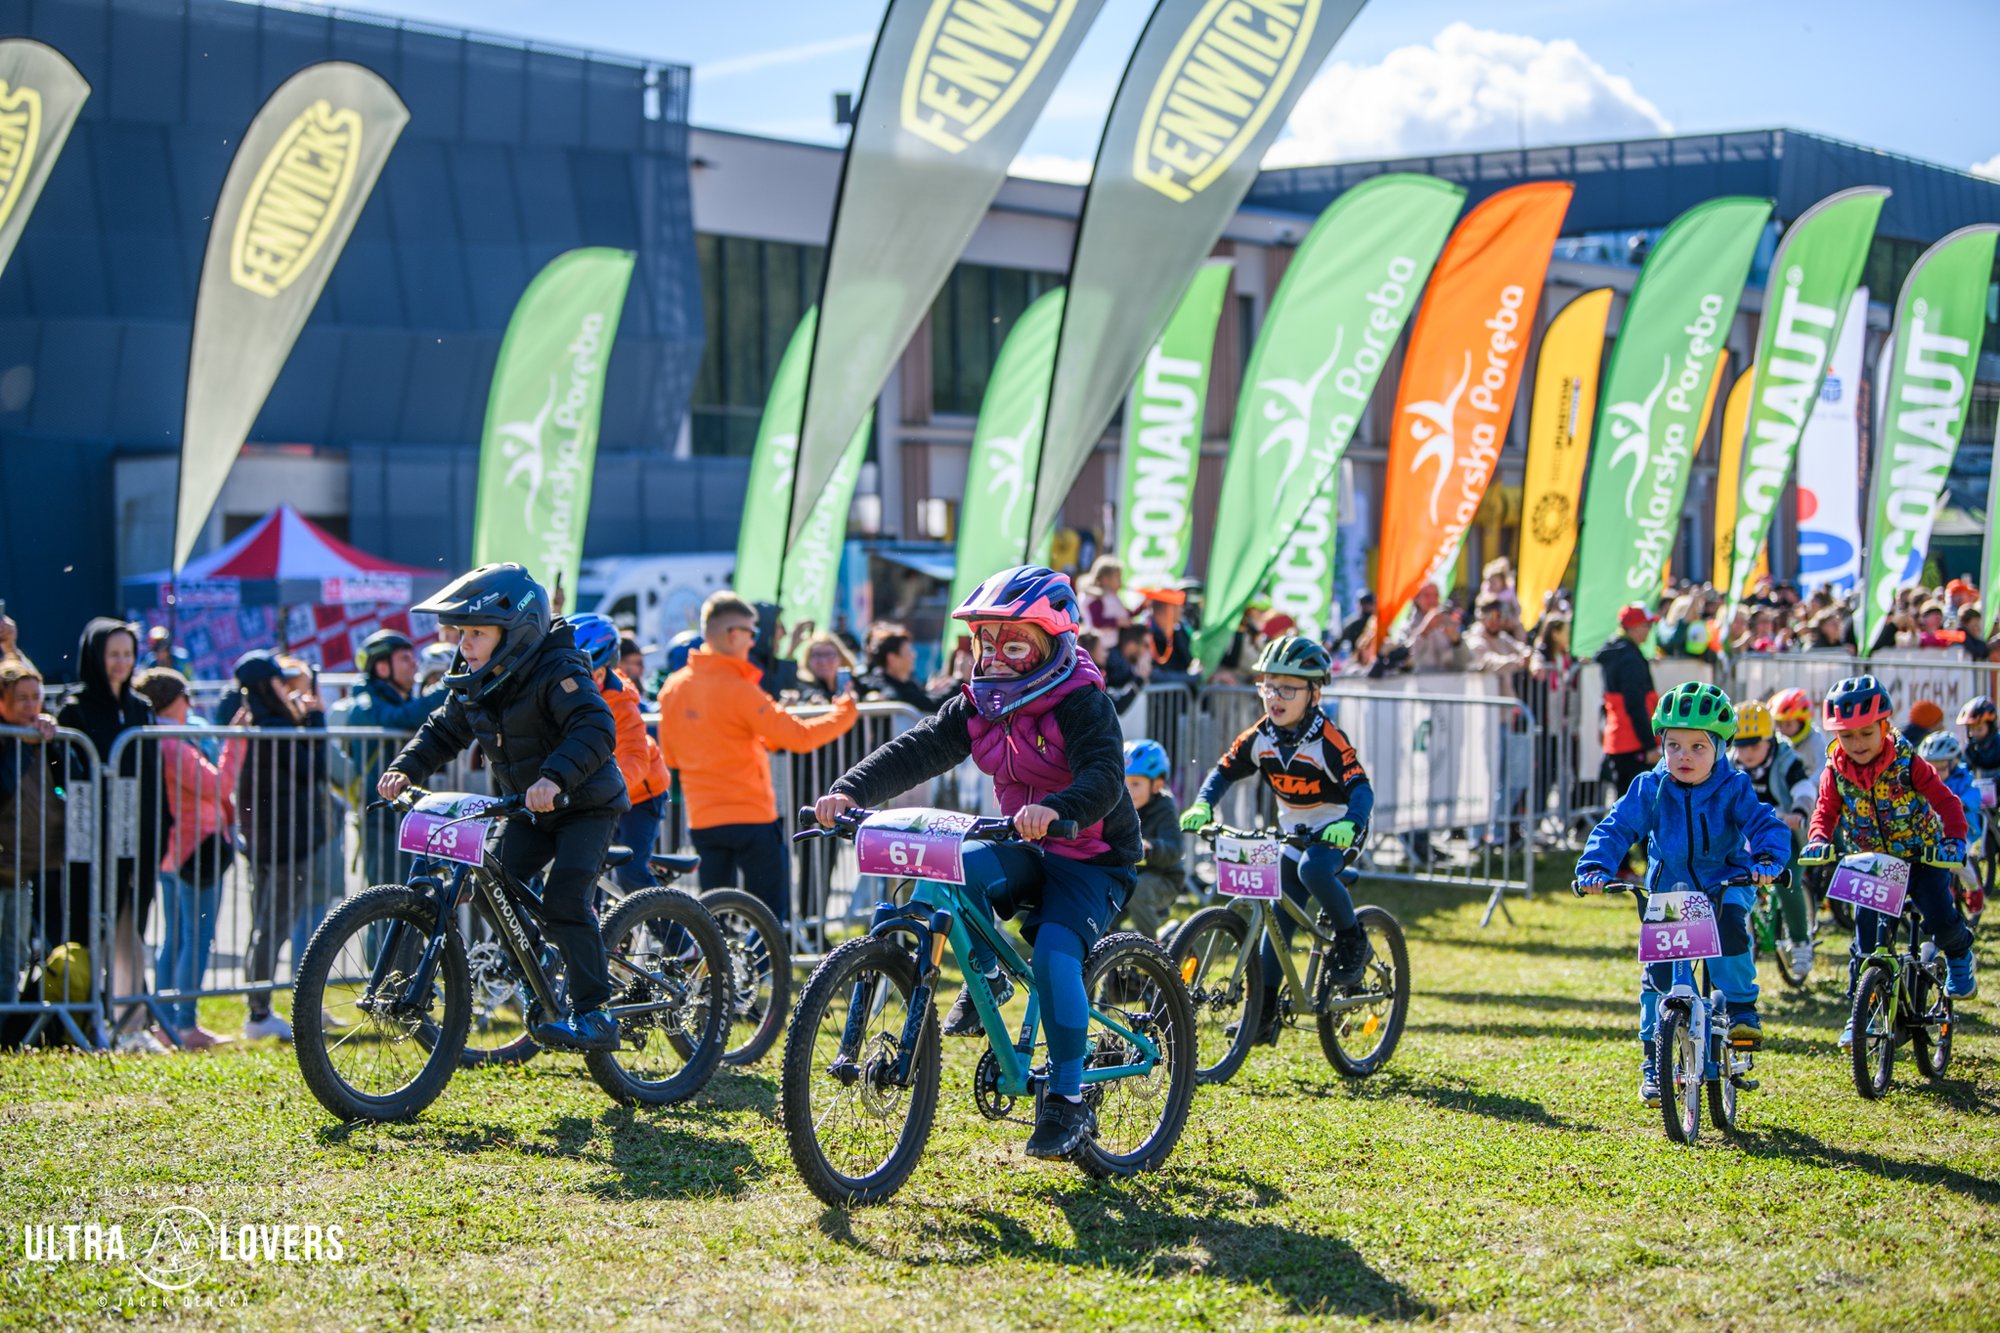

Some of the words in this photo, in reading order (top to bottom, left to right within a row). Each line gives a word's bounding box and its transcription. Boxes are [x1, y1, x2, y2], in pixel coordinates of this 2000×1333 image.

[1336, 254, 1417, 400] Poręba
[1470, 284, 1525, 414] Poręba
[1626, 422, 1687, 591] Szklarska
[1666, 293, 1724, 414] Poręba
[1267, 773, 1321, 796] KTM
[427, 822, 458, 849] 53
[889, 841, 927, 867] 67
[1228, 869, 1264, 889] 145
[1849, 878, 1890, 903] 135
[1655, 929, 1691, 951] 34
[713, 971, 730, 1044] KENDA
